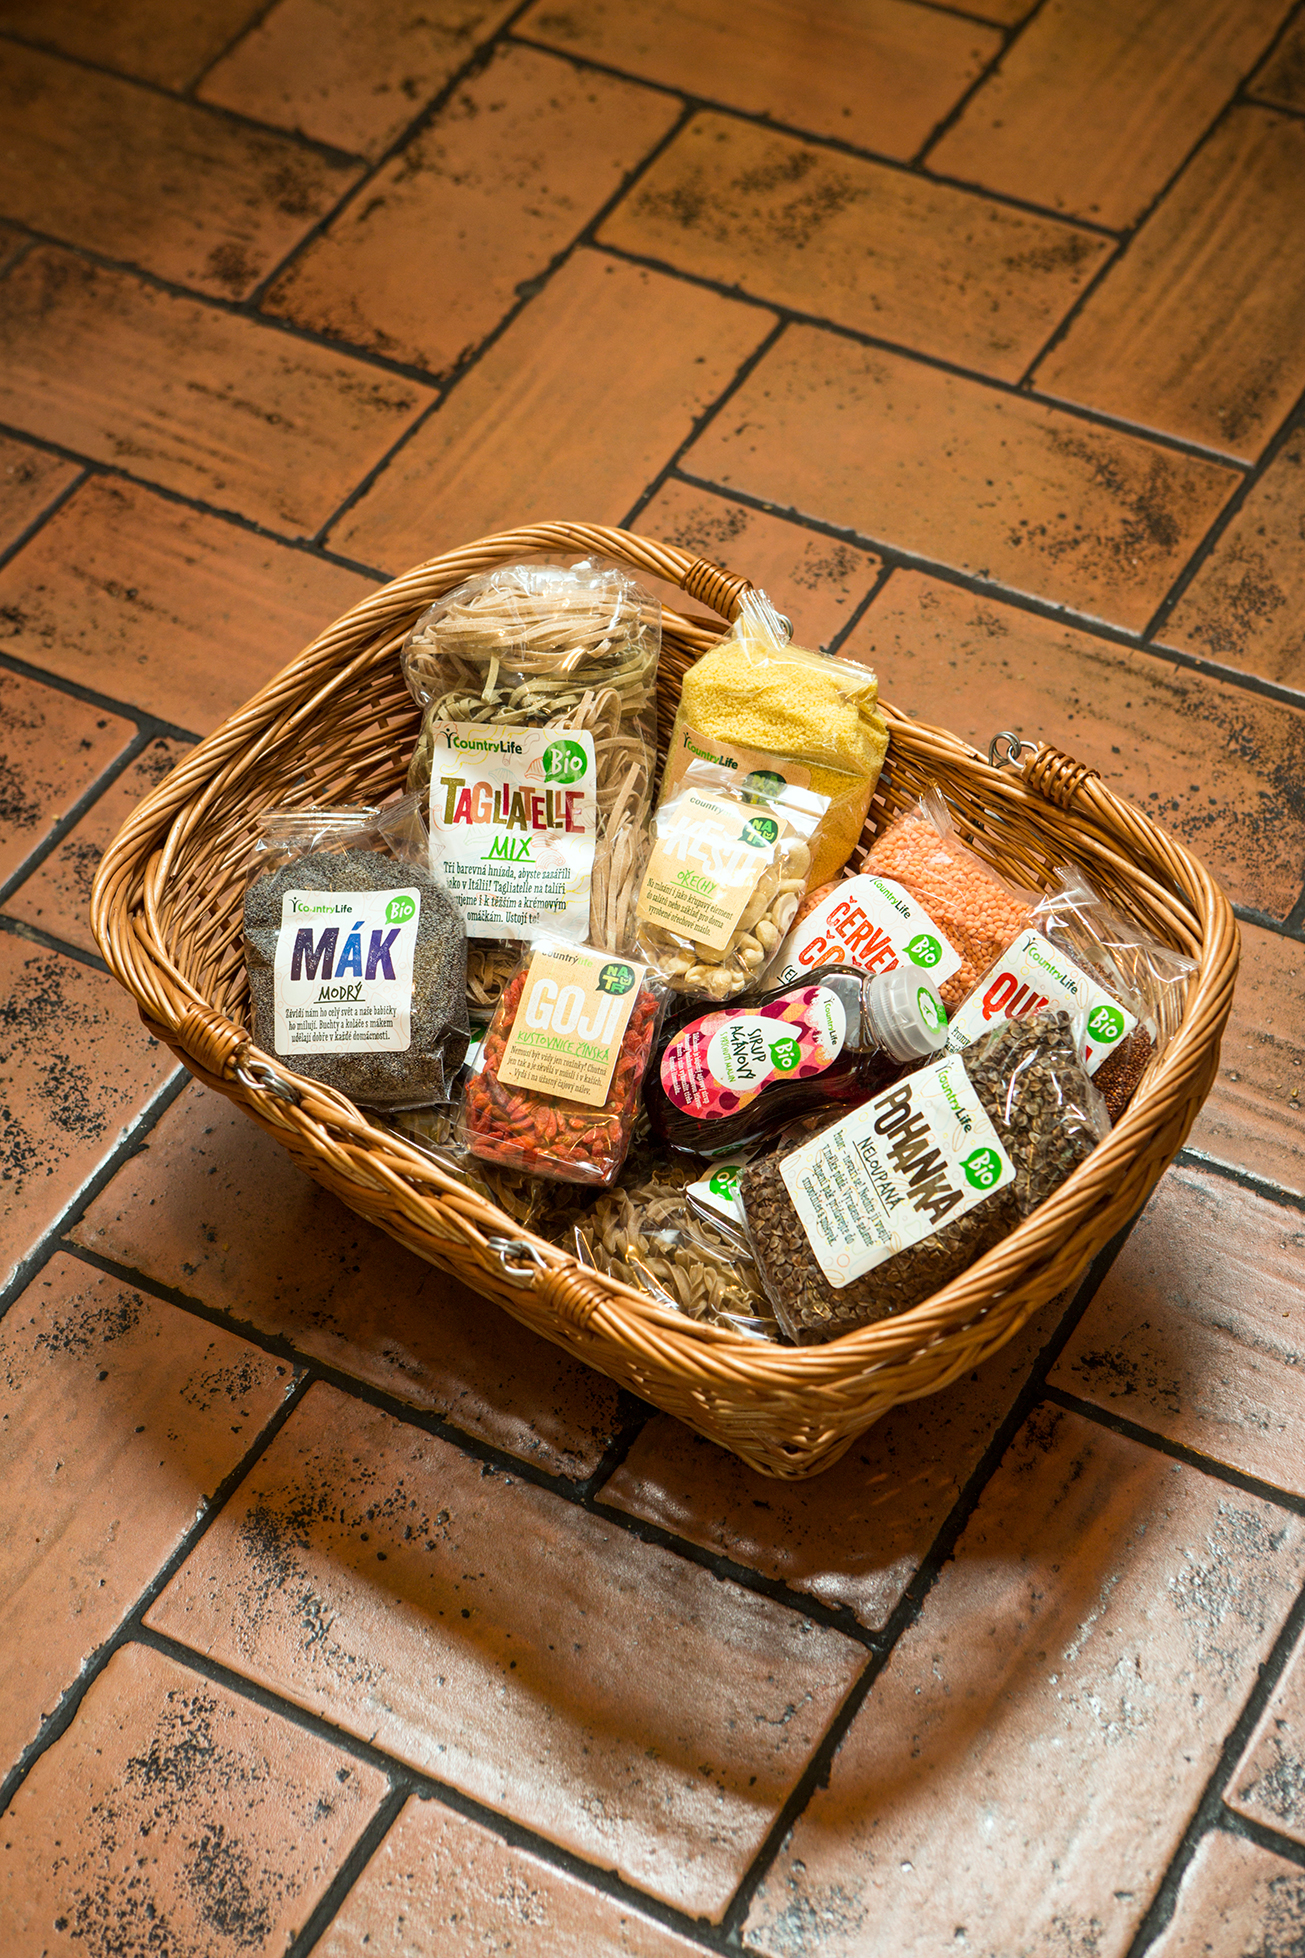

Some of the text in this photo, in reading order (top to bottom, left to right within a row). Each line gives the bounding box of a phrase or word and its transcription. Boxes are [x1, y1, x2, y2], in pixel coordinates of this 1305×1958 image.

[453, 737, 522, 754] CountryLife
[687, 741, 738, 770] CountryLife
[551, 748, 583, 775] Bio
[440, 777, 585, 833] TAGLIATELLE
[488, 835, 532, 860] MIX
[444, 862, 570, 880] Tři barevná hnízda, abyste zazářili
[677, 870, 717, 894] OŘECHY
[468, 879, 492, 891] Itálii!
[494, 881, 532, 895] Tagliatelle
[534, 885, 542, 893] na
[545, 883, 565, 894] talíři
[873, 879, 911, 919] CountryLife
[298, 903, 352, 914] CountryLife
[391, 902, 412, 919] Bio
[484, 895, 488, 906] k
[491, 897, 516, 908] těžším
[524, 897, 566, 912] krémovým
[467, 911, 503, 922] omáčkám.
[506, 912, 527, 925] Ustojí
[291, 921, 401, 981] MÁK
[911, 937, 936, 963] Bio
[1028, 947, 1077, 995] CountryLife
[318, 982, 362, 1001] MODRÝ
[526, 979, 624, 1045] GOJI
[1090, 1008, 1118, 1037] Bio
[517, 1030, 609, 1061] KUSTOVNICE ČÍNSKÁ
[730, 1026, 756, 1079] AGÁVOVÝ
[748, 1028, 766, 1062] SIRUP
[775, 1041, 792, 1068] Bio
[725, 1062, 736, 1082] MALIN
[938, 1070, 972, 1133] CountryLife
[874, 1084, 964, 1225] POHANKA
[968, 1151, 993, 1185] Bio
[853, 1136, 904, 1210] NELOUPANÁ
